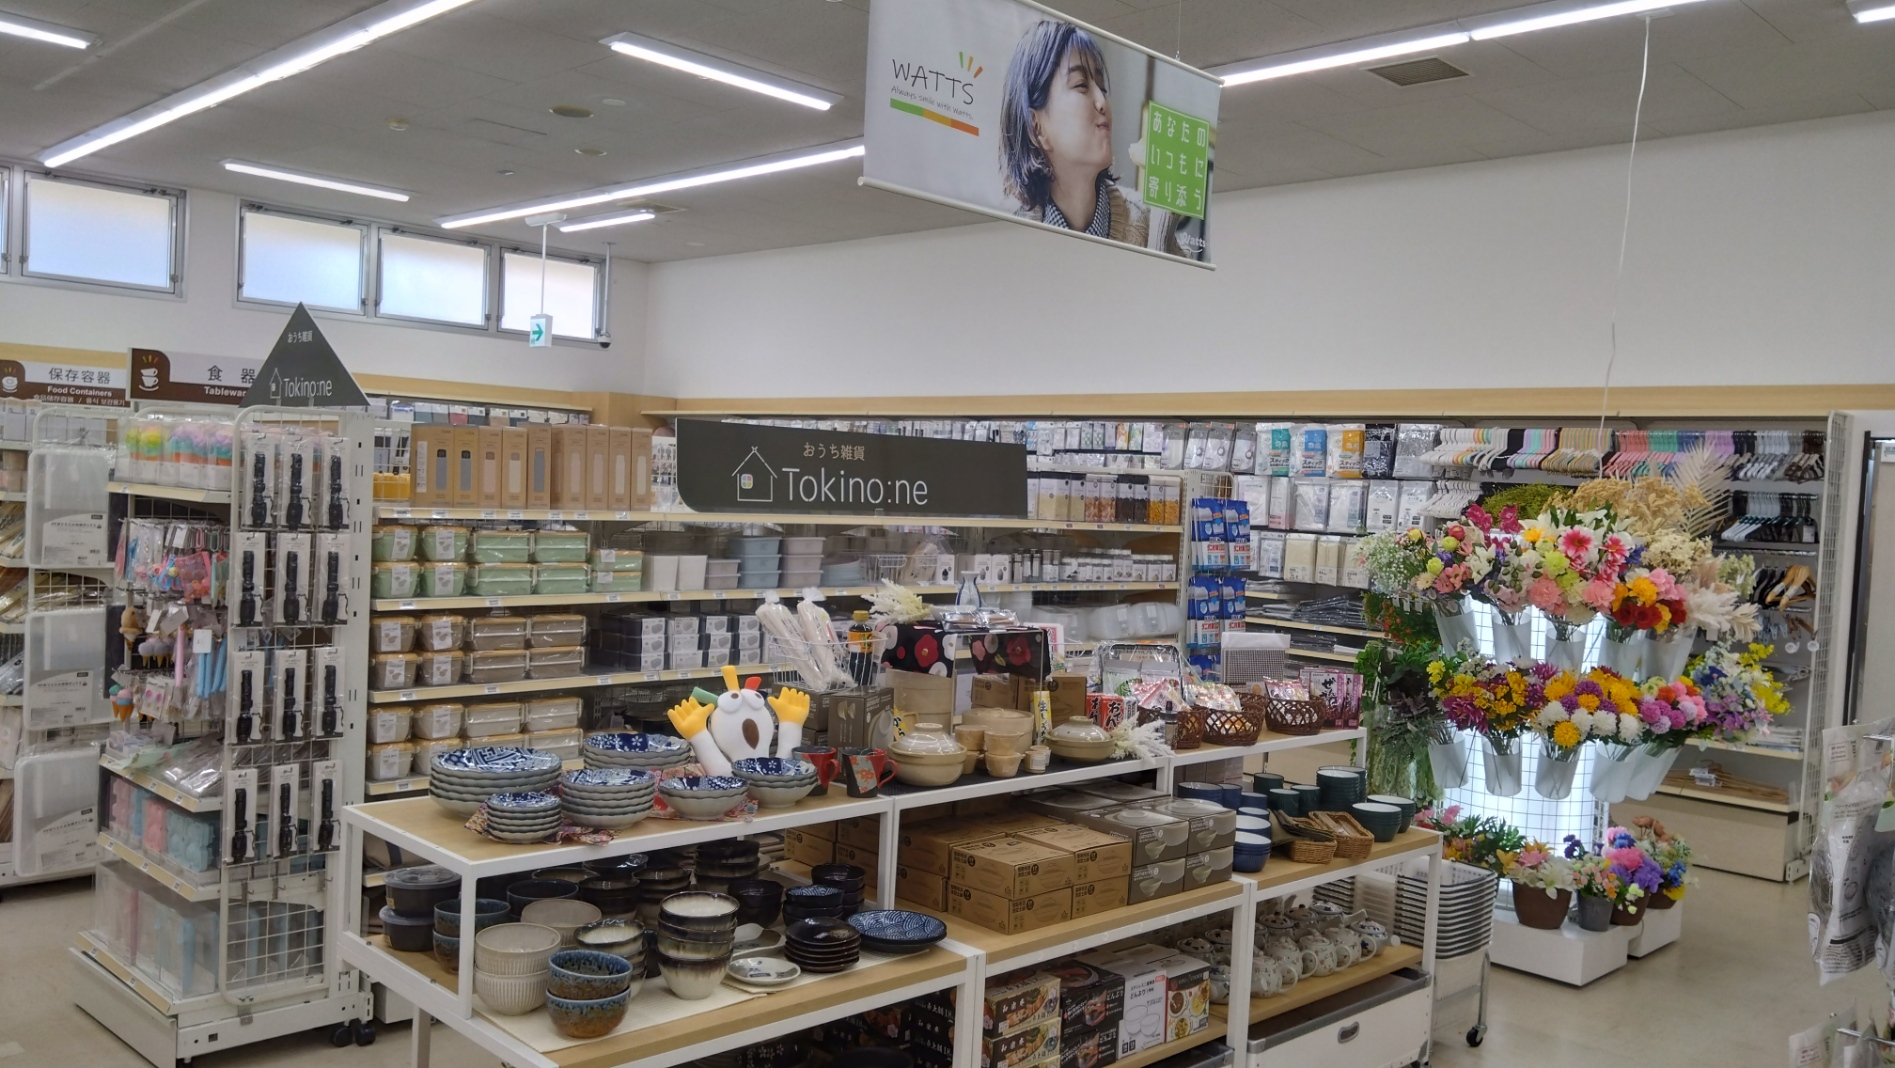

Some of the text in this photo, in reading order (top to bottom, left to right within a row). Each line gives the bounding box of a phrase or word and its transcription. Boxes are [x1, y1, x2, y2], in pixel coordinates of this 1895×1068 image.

[892, 59, 974, 105] WATTS
[891, 85, 974, 121] Always smile with Watts.
[1152, 111, 1206, 147] あなたの
[1151, 144, 1204, 178] いつもに
[1149, 176, 1201, 210] 寄り添う
[1179, 232, 1206, 248] Watts
[287, 330, 313, 343] おうち雑貨
[49, 366, 111, 385] 保存容器
[47, 385, 112, 397] Food Containers
[204, 385, 247, 397] Tablewar
[283, 376, 333, 398] Tokino:ne
[802, 442, 865, 461] おうち雑貨
[782, 467, 928, 505] Tokino:ne
[1105, 701, 1122, 730] おでん
[1107, 989, 1124, 1001] どんぶり
[1129, 988, 1146, 1000] どんぶり
